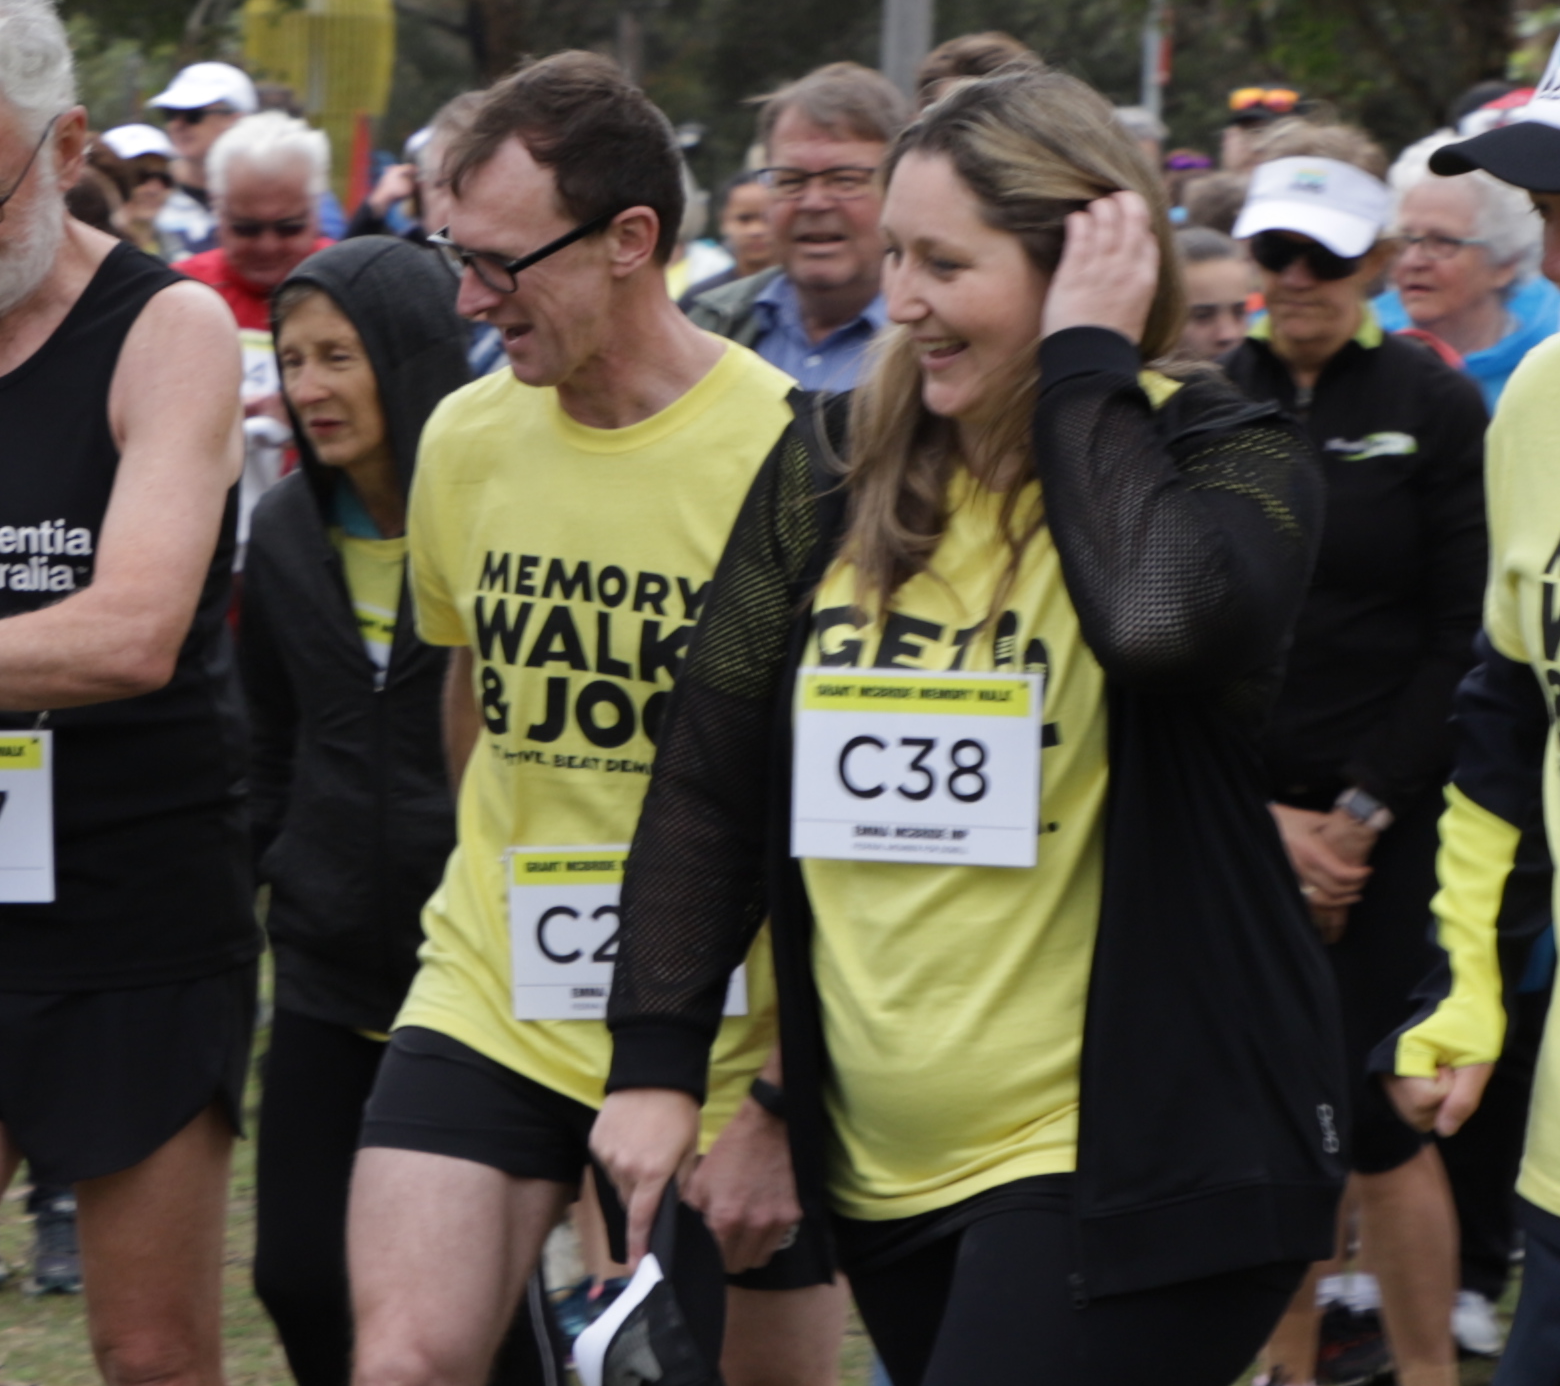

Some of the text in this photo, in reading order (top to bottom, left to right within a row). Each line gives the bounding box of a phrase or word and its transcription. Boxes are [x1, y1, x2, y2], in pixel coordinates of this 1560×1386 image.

[478, 550, 714, 619] MEMORY
[475, 595, 697, 684] WALK
[481, 666, 672, 749] & JO
[837, 733, 991, 804] C38
[536, 904, 622, 964] C2
